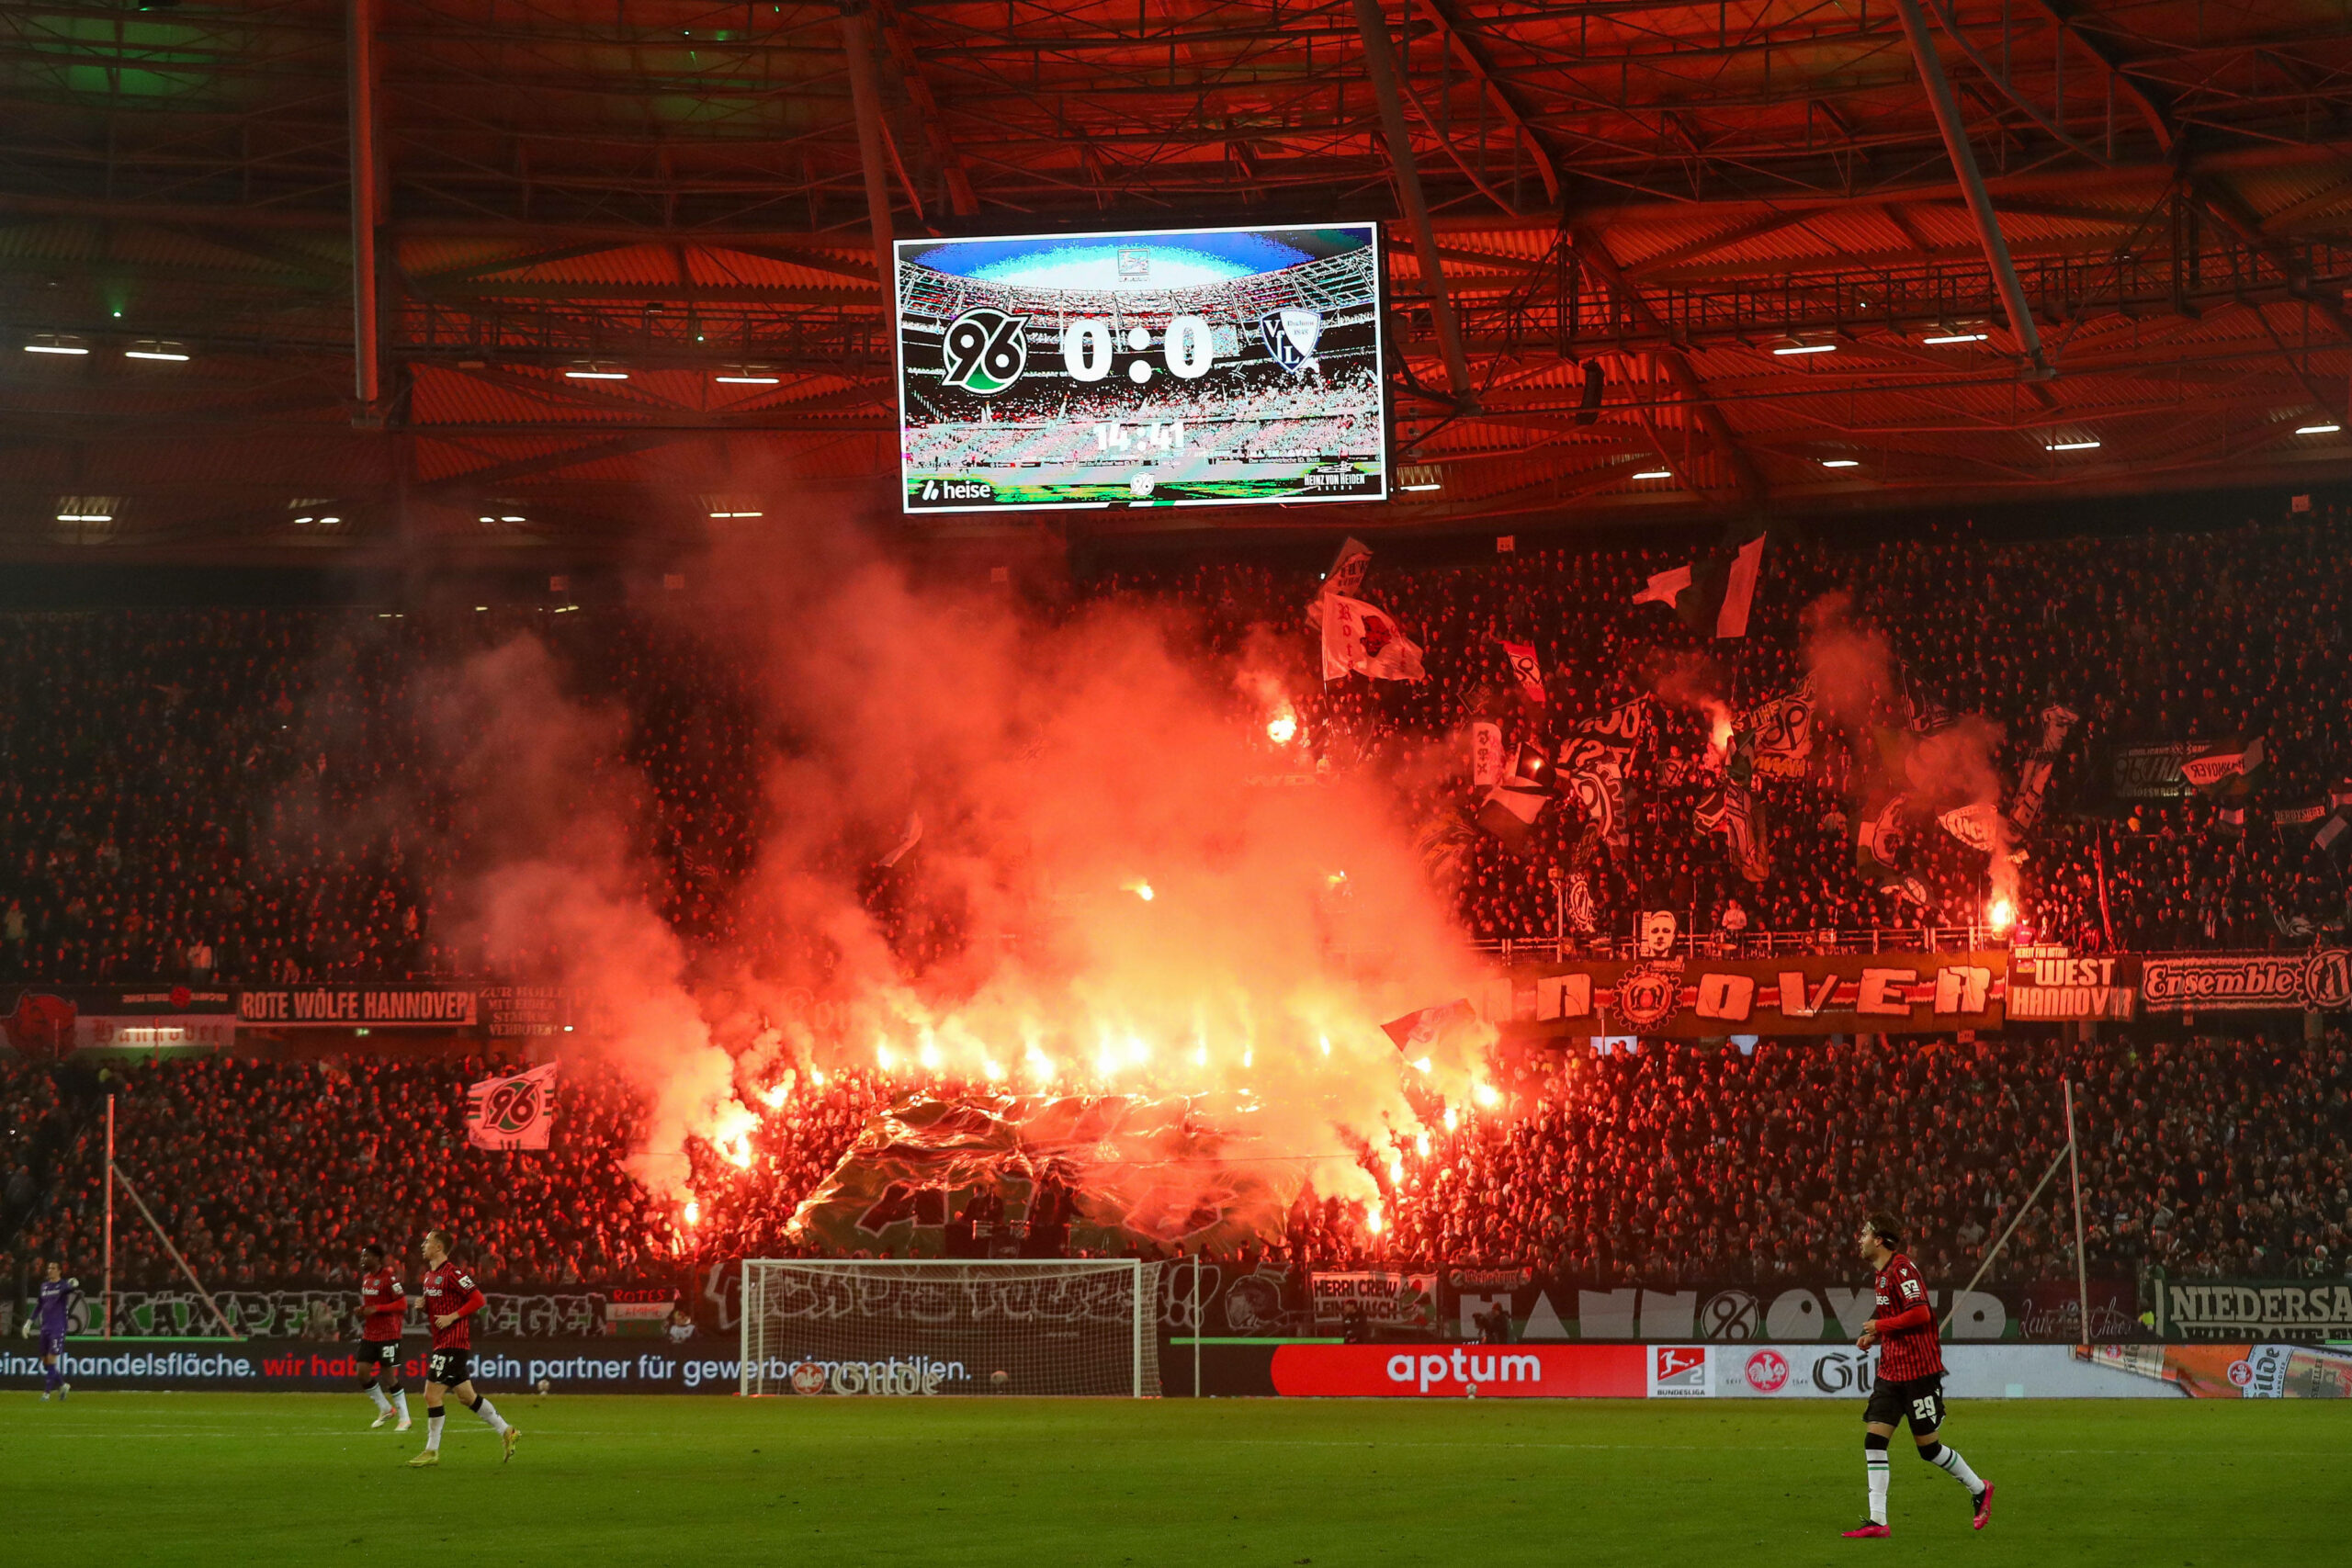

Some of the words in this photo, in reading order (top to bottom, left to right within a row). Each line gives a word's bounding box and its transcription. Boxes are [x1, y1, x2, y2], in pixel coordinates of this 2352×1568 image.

[943, 309, 1031, 391] 96
[1093, 421, 1184, 452] 14:41
[943, 480, 990, 499] heise
[2035, 958, 2116, 986] WEST
[2146, 964, 2294, 999] Ensemble
[243, 991, 288, 1020] ROTE
[293, 987, 359, 1020] WÖLFE
[480, 1076, 544, 1134] 96
[1314, 1280, 1355, 1298] HERRI
[1314, 1301, 1397, 1321] LEINMASCH
[382, 1346, 395, 1358] 20
[430, 1354, 446, 1371] 33
[263, 1353, 303, 1376] wir
[466, 1354, 521, 1378] dein
[528, 1356, 632, 1386] partner
[638, 1355, 676, 1379] für
[1386, 1348, 1541, 1393] aptum
[1690, 1367, 1702, 1383] 2
[1913, 1395, 1936, 1420] 29
